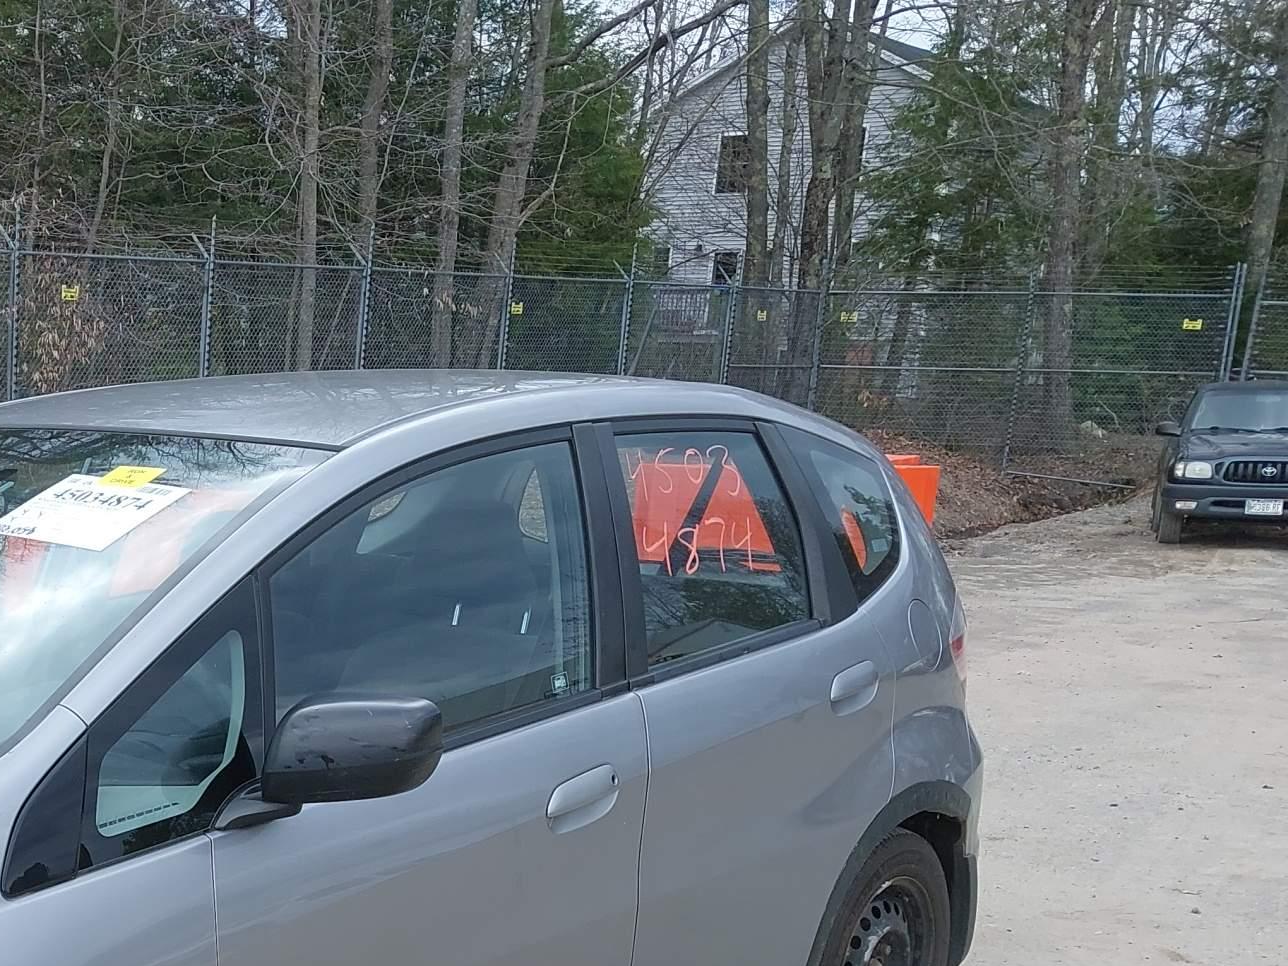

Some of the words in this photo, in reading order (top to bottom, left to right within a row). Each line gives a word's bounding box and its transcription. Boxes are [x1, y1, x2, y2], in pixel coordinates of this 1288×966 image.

[53, 488, 153, 510] 45034874
[623, 445, 741, 501] 4503
[642, 517, 753, 577] 4874
